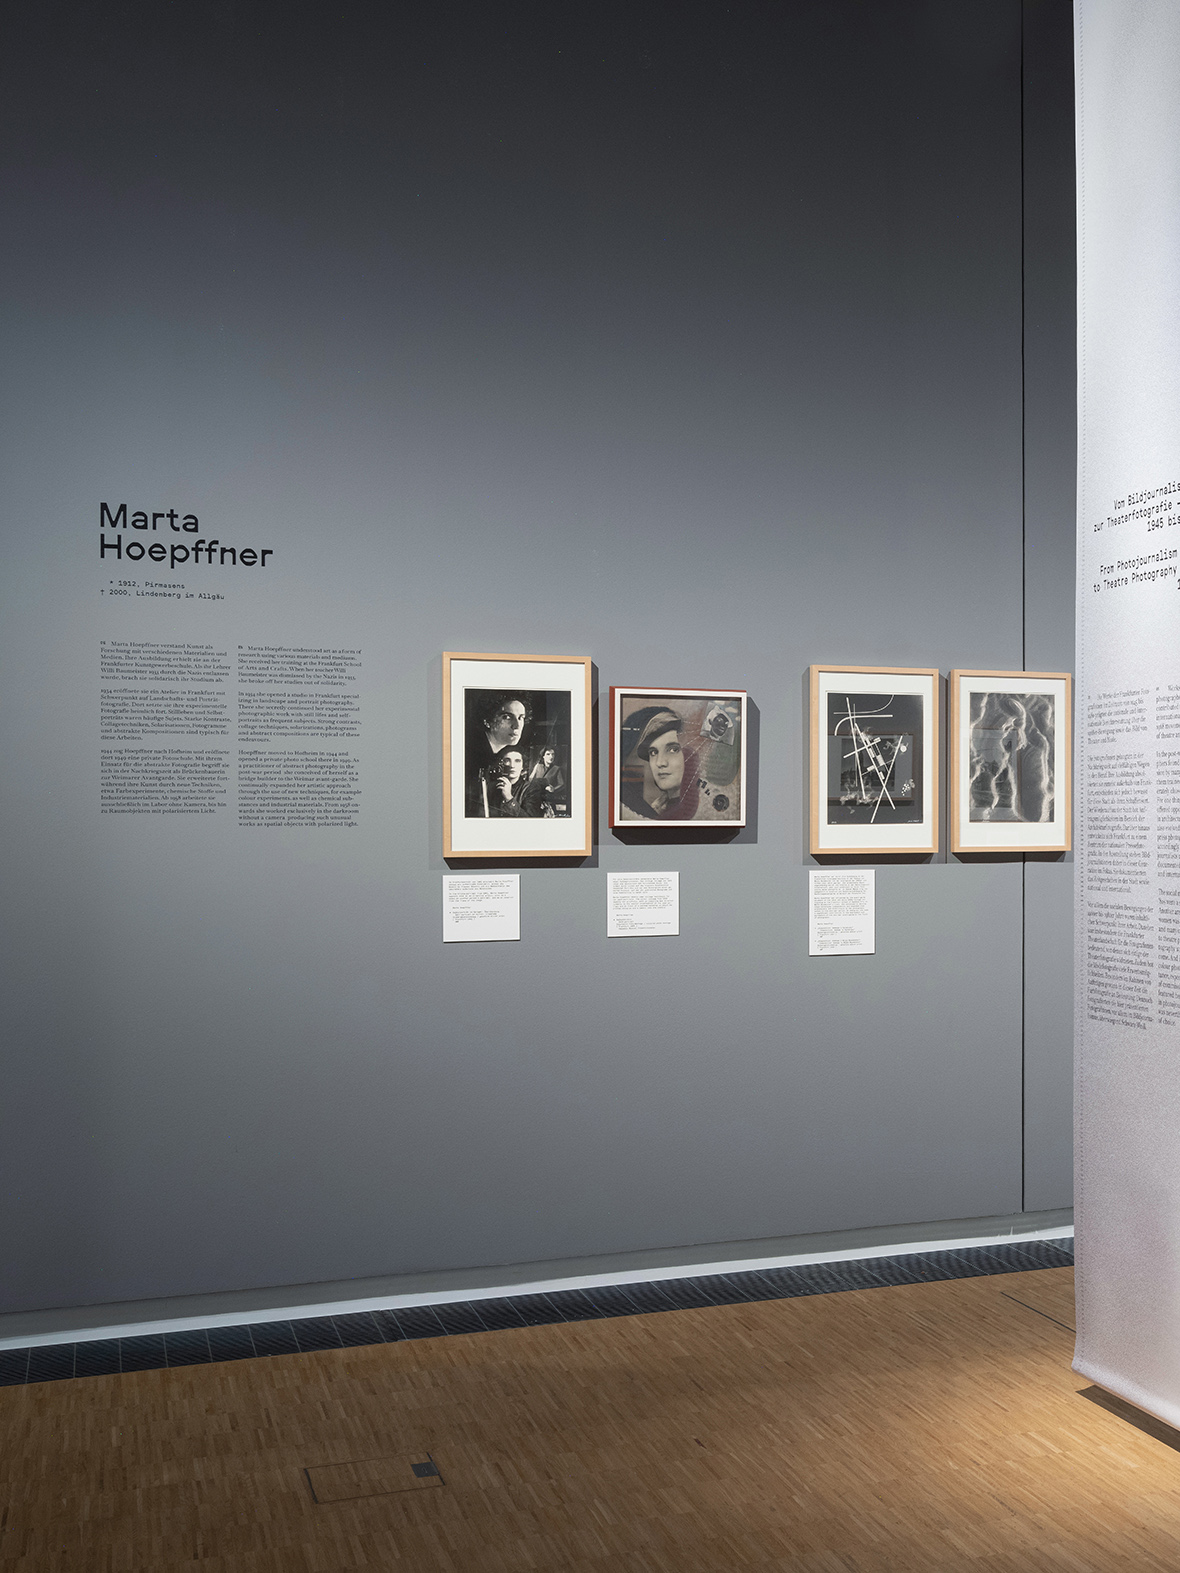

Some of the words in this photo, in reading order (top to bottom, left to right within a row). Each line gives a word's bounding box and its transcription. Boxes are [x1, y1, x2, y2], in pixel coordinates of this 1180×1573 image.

[100, 502, 199, 533] Marta
[1094, 522, 1103, 532] zur
[1107, 500, 1172, 528] Theaterfotografie
[1114, 500, 1125, 510] Vom
[1148, 518, 1164, 532] 1945
[100, 534, 273, 569] Hoepffner
[1100, 564, 1114, 576] From
[1117, 548, 1177, 570] Photojournalism
[118, 580, 140, 588] 1912,
[1094, 583, 1100, 593] to
[1104, 576, 1128, 590] Theatre
[1132, 565, 1177, 583] Photography
[136, 590, 181, 599] Lindenberg
[198, 593, 225, 601] Allgäu
